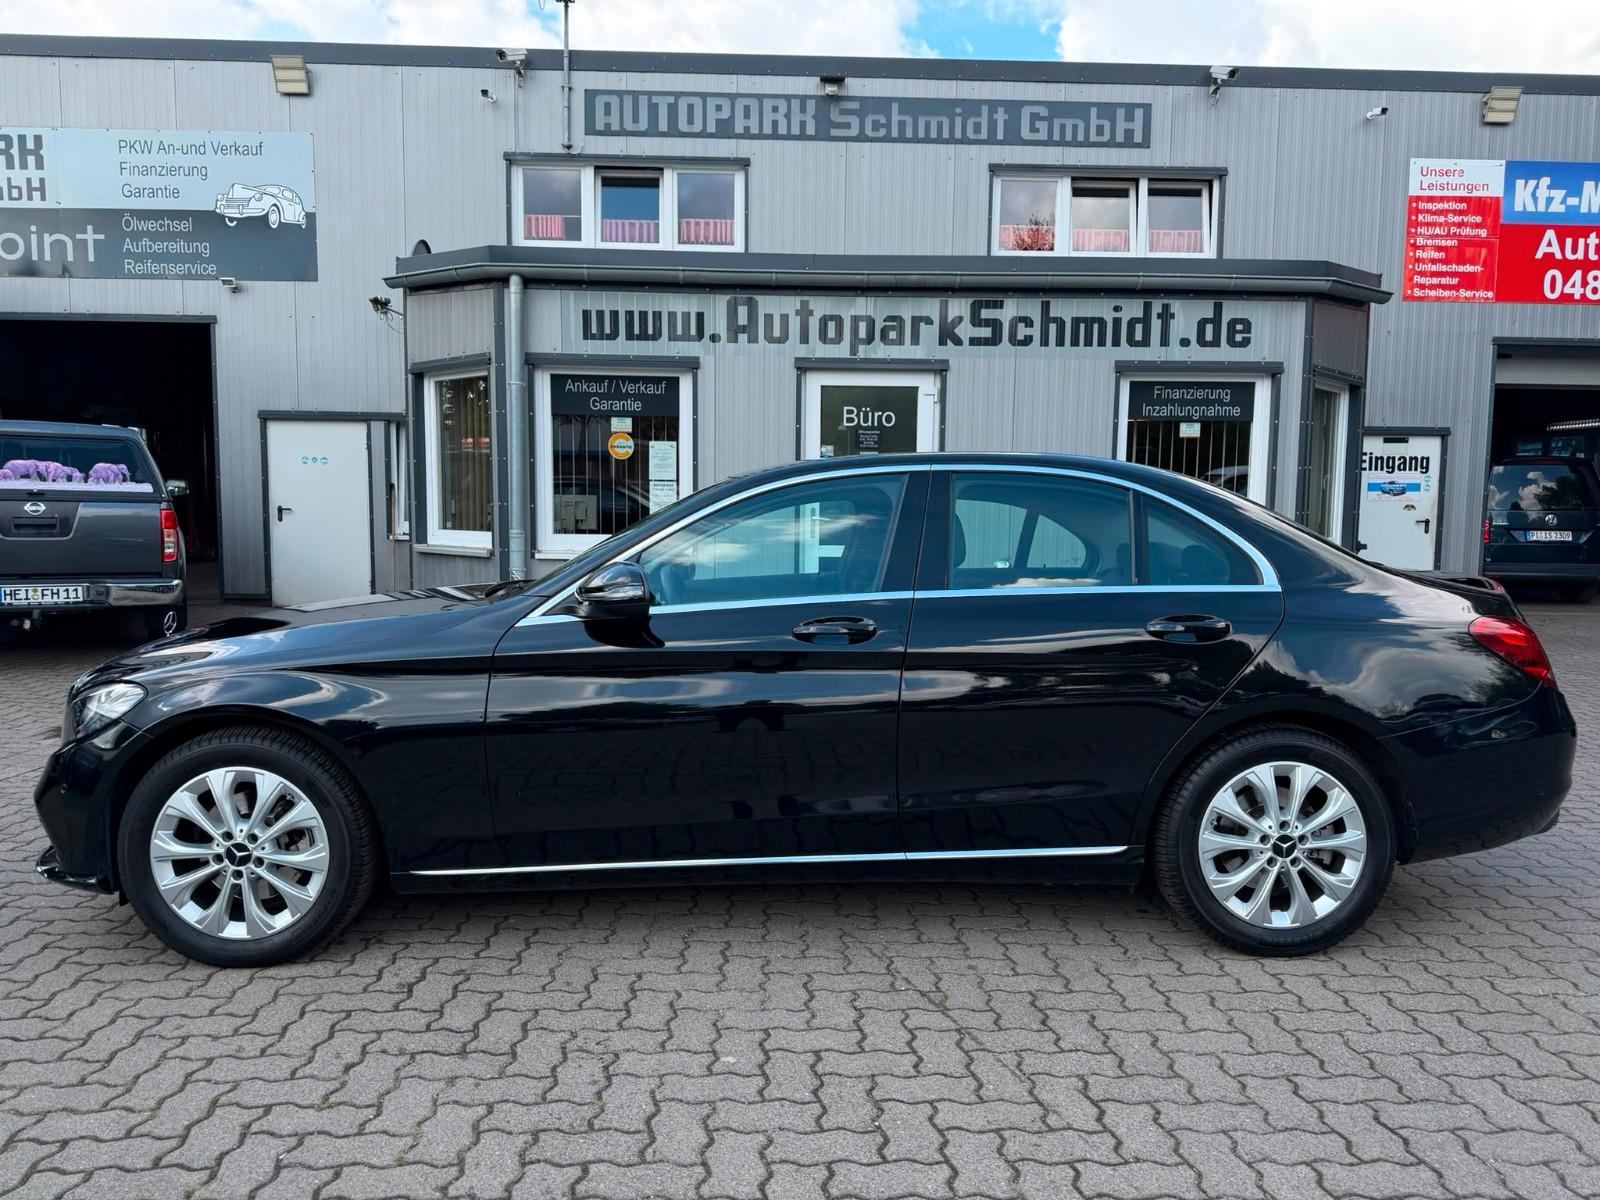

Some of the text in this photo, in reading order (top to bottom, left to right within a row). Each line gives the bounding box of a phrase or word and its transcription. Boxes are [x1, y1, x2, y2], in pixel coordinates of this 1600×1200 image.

[595, 94, 1144, 143] AUTOPARK Schmidt GmbH
[118, 139, 264, 157] PKW An-und Verkauf
[119, 162, 208, 181] Finanzierung
[1420, 166, 1465, 177] Unsere
[121, 183, 180, 199] Garantie
[1419, 180, 1489, 194] Leistungen
[1418, 201, 1467, 211] Inspektion
[122, 213, 192, 232] Ölwechsel
[1417, 214, 1482, 223] Klima-Service
[1417, 227, 1487, 238] HU/AU Prüfung
[123, 238, 211, 257] Aufbereitung
[1416, 238, 1458, 247] Bremsen
[1535, 229, 1599, 260] Aut
[1415, 250, 1445, 259] Reifen
[124, 259, 217, 275] Reifenservice
[1415, 263, 1485, 273] Unfallschaden-
[1413, 276, 1460, 286] Reparatur
[1543, 269, 1600, 300] 048
[1413, 288, 1494, 298] Scheiben-Service
[582, 296, 1252, 356] www.AutoparkSchmidt.de
[565, 379, 608, 393] Ankauf
[619, 380, 667, 395] Verkauf
[1154, 386, 1231, 402] Finanzierung
[590, 396, 642, 411] Garantie
[1142, 403, 1241, 419] Inzahlungnahme
[843, 406, 896, 427] Büro
[1360, 452, 1430, 474] Eingang
[3, 588, 81, 600] HEI FH 11
